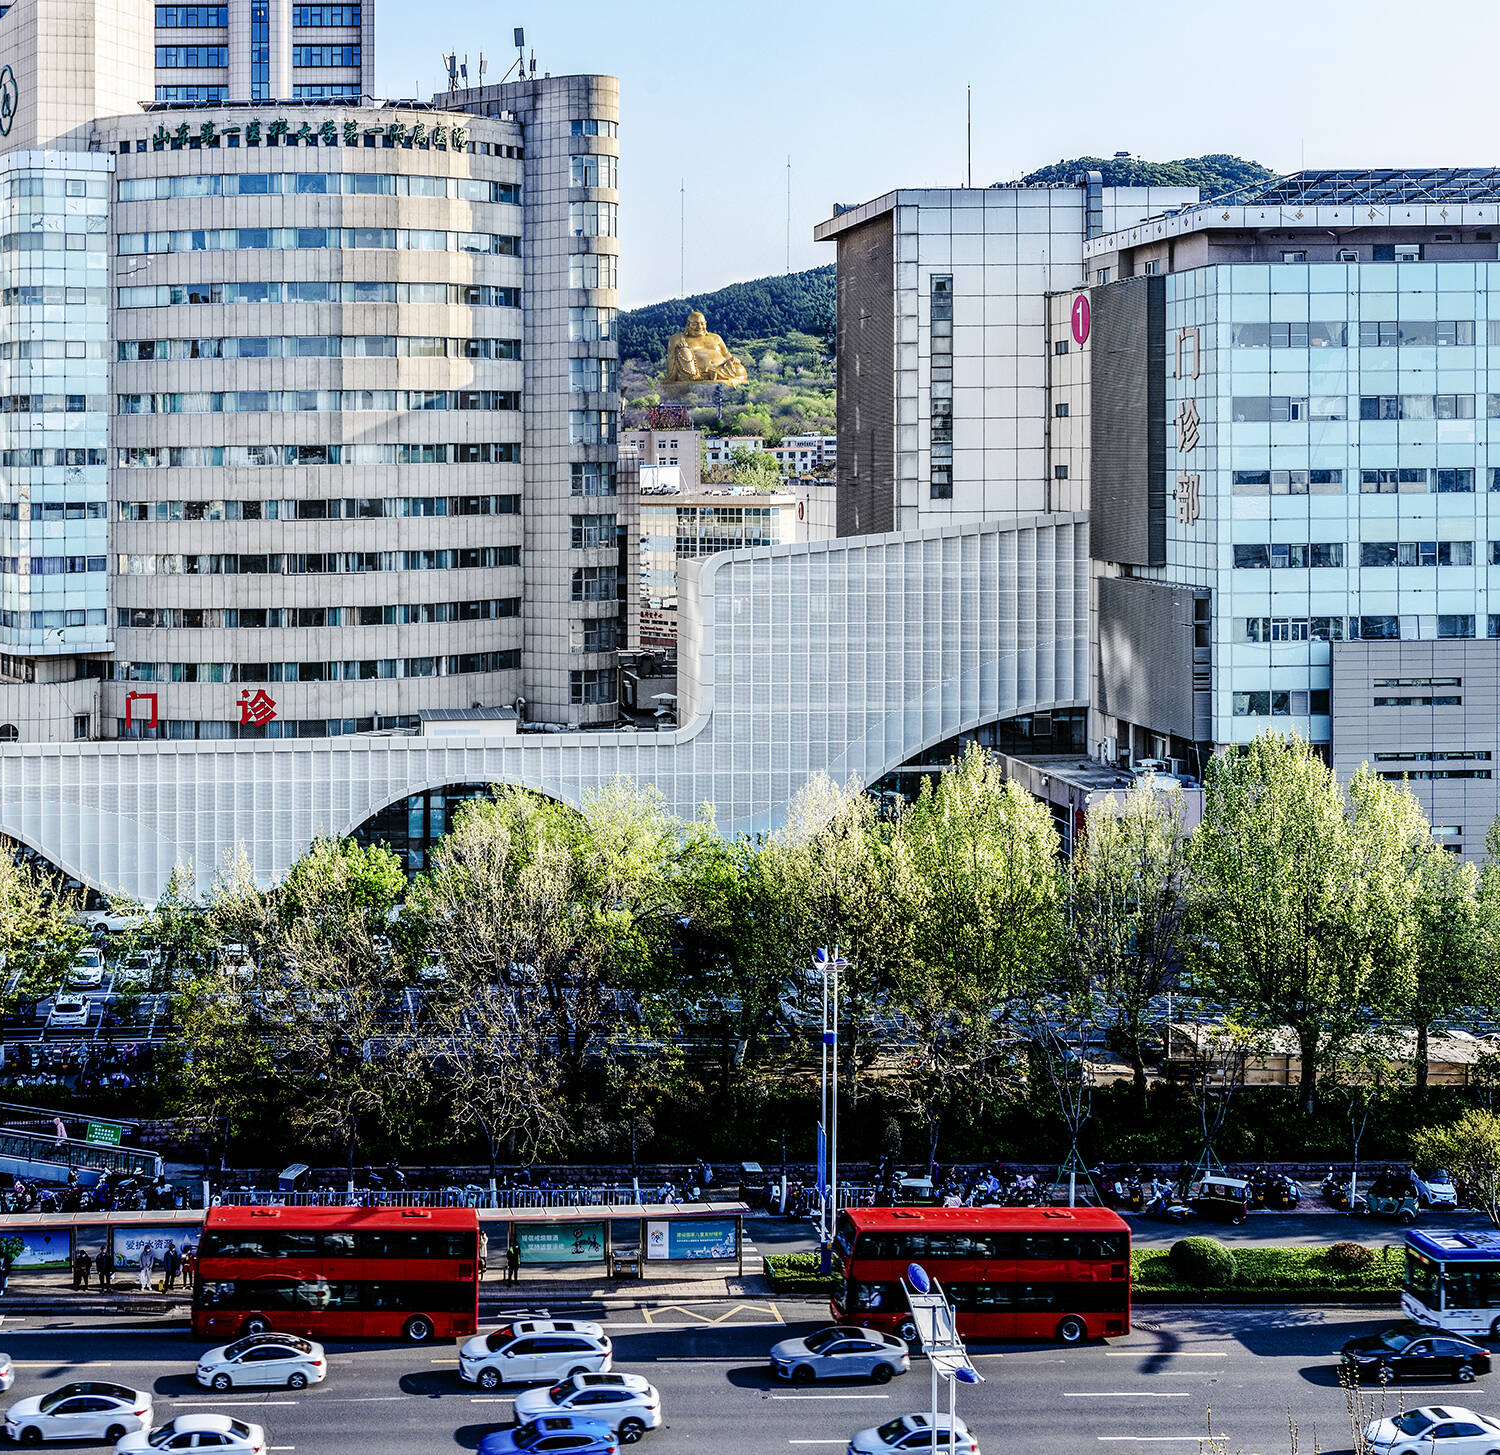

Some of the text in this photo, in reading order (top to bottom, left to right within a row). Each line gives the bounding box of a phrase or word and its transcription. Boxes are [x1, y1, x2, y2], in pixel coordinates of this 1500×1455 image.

[153, 119, 469, 149] 山东第一医科大学第一附属医院
[1076, 301, 1087, 337] 1
[1175, 326, 1201, 526] 门诊部
[125, 689, 277, 729] 门诊
